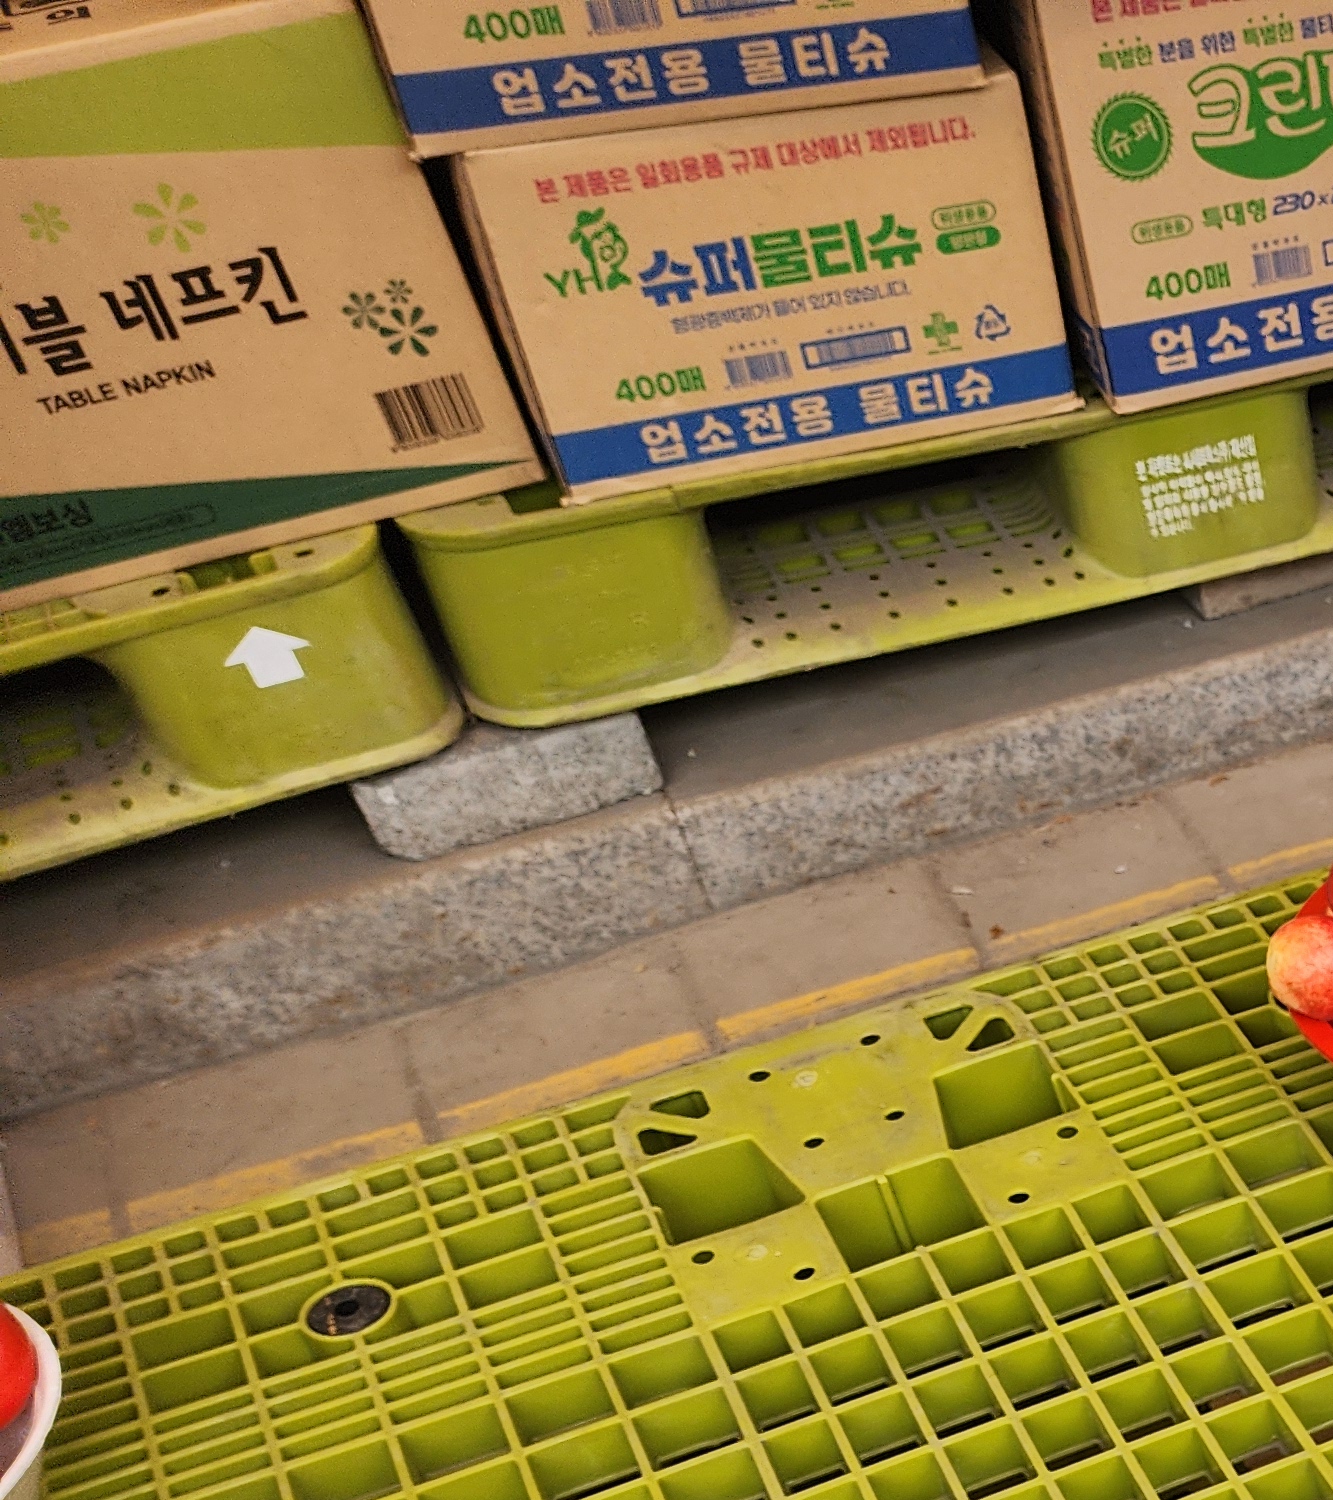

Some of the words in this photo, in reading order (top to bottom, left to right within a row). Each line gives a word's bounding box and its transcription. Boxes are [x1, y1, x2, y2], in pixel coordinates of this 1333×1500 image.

[463, 13, 565, 43] 400매
[1200, 30, 1236, 56] 위한
[491, 49, 710, 116] 업소전용
[738, 27, 891, 86] 물티슈
[534, 178, 560, 204] 본
[563, 167, 633, 198] 제품은
[635, 153, 725, 189] 일회용품
[727, 147, 774, 175] 규제
[776, 133, 863, 166] 대상에서
[866, 116, 976, 152] 제외됩니다.
[1108, 112, 1158, 160] 슈퍼
[1201, 198, 1268, 231] 특대형
[638, 213, 923, 307] 슈퍼물티슈
[1145, 261, 1230, 300] 400매
[99, 247, 309, 341] 네프킨
[36, 382, 118, 415] TABLE
[121, 359, 217, 397] NAPKIN
[615, 366, 707, 402] 400매
[640, 396, 833, 465] 업소전용
[859, 368, 994, 425] 물티슈
